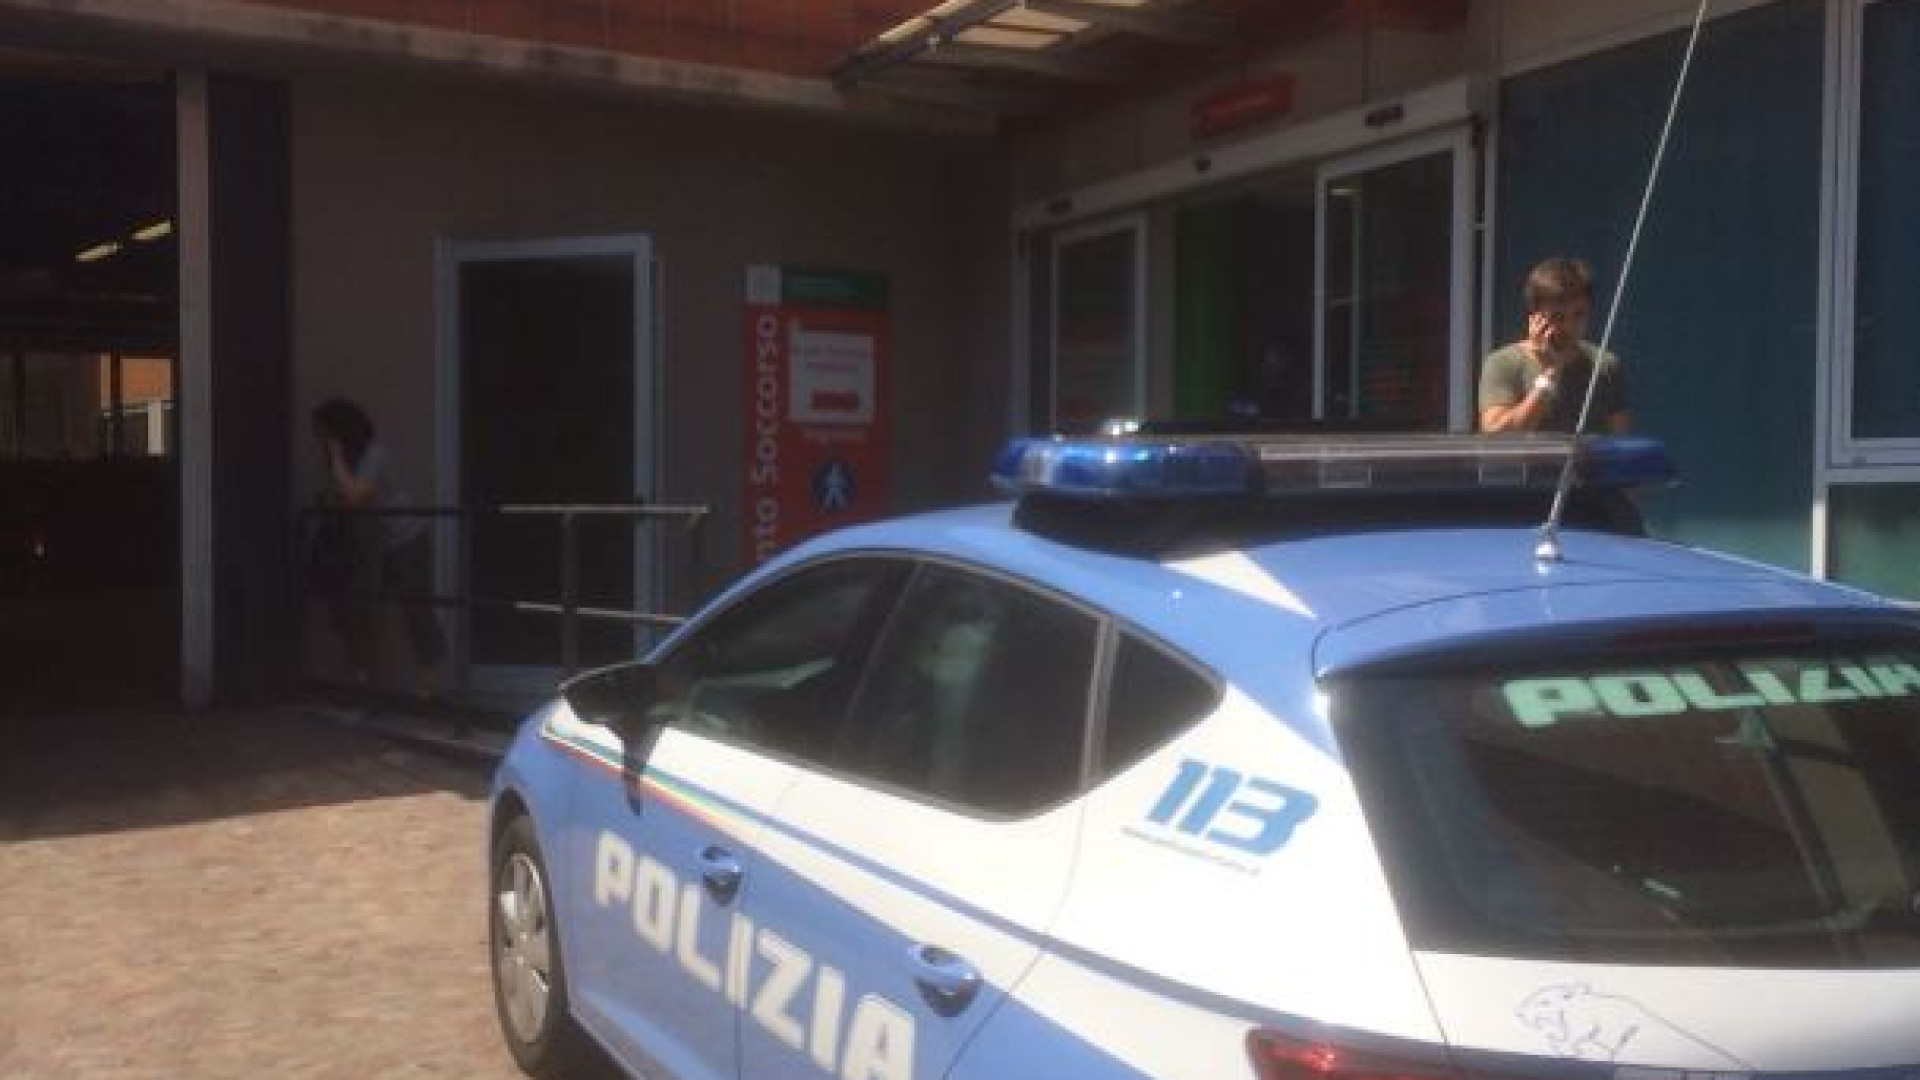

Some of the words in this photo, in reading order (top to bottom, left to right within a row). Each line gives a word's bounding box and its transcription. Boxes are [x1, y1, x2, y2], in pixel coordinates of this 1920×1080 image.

[750, 313, 780, 485] Soccorso
[1145, 760, 1321, 857] 113
[594, 829, 916, 1080] POLIZIA
